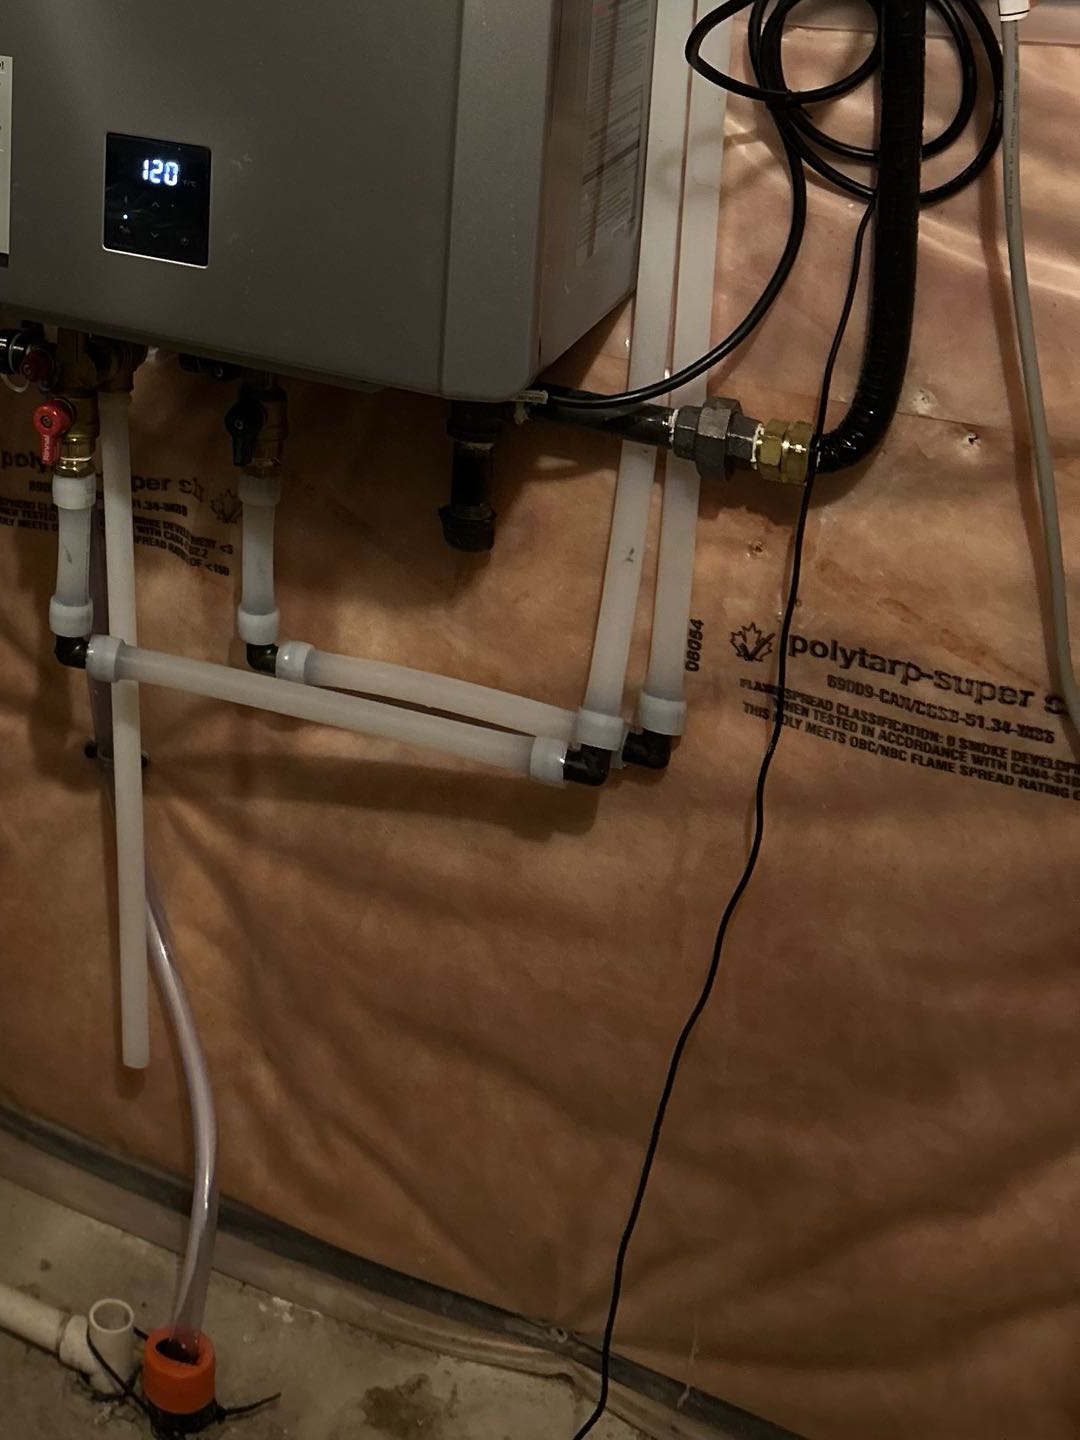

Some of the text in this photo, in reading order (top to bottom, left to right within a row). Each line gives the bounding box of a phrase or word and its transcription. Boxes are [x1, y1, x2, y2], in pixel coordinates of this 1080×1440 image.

[142, 159, 179, 187] 120
[133, 534, 167, 549] PREAD
[788, 634, 1035, 707] polytarp-super
[739, 677, 780, 695] FLAM
[784, 687, 833, 711] SPREAD
[837, 702, 943, 744] CLASSIFICATION:
[959, 737, 1008, 759] SMOKE
[743, 701, 1069, 799] THIS OLY MEETS OBC/NBC FLAME SPREAD RATING
[809, 708, 858, 733] TESTED
[861, 721, 875, 737] IN
[878, 727, 969, 761] ACCORDANCE
[971, 753, 1007, 772] WITH
